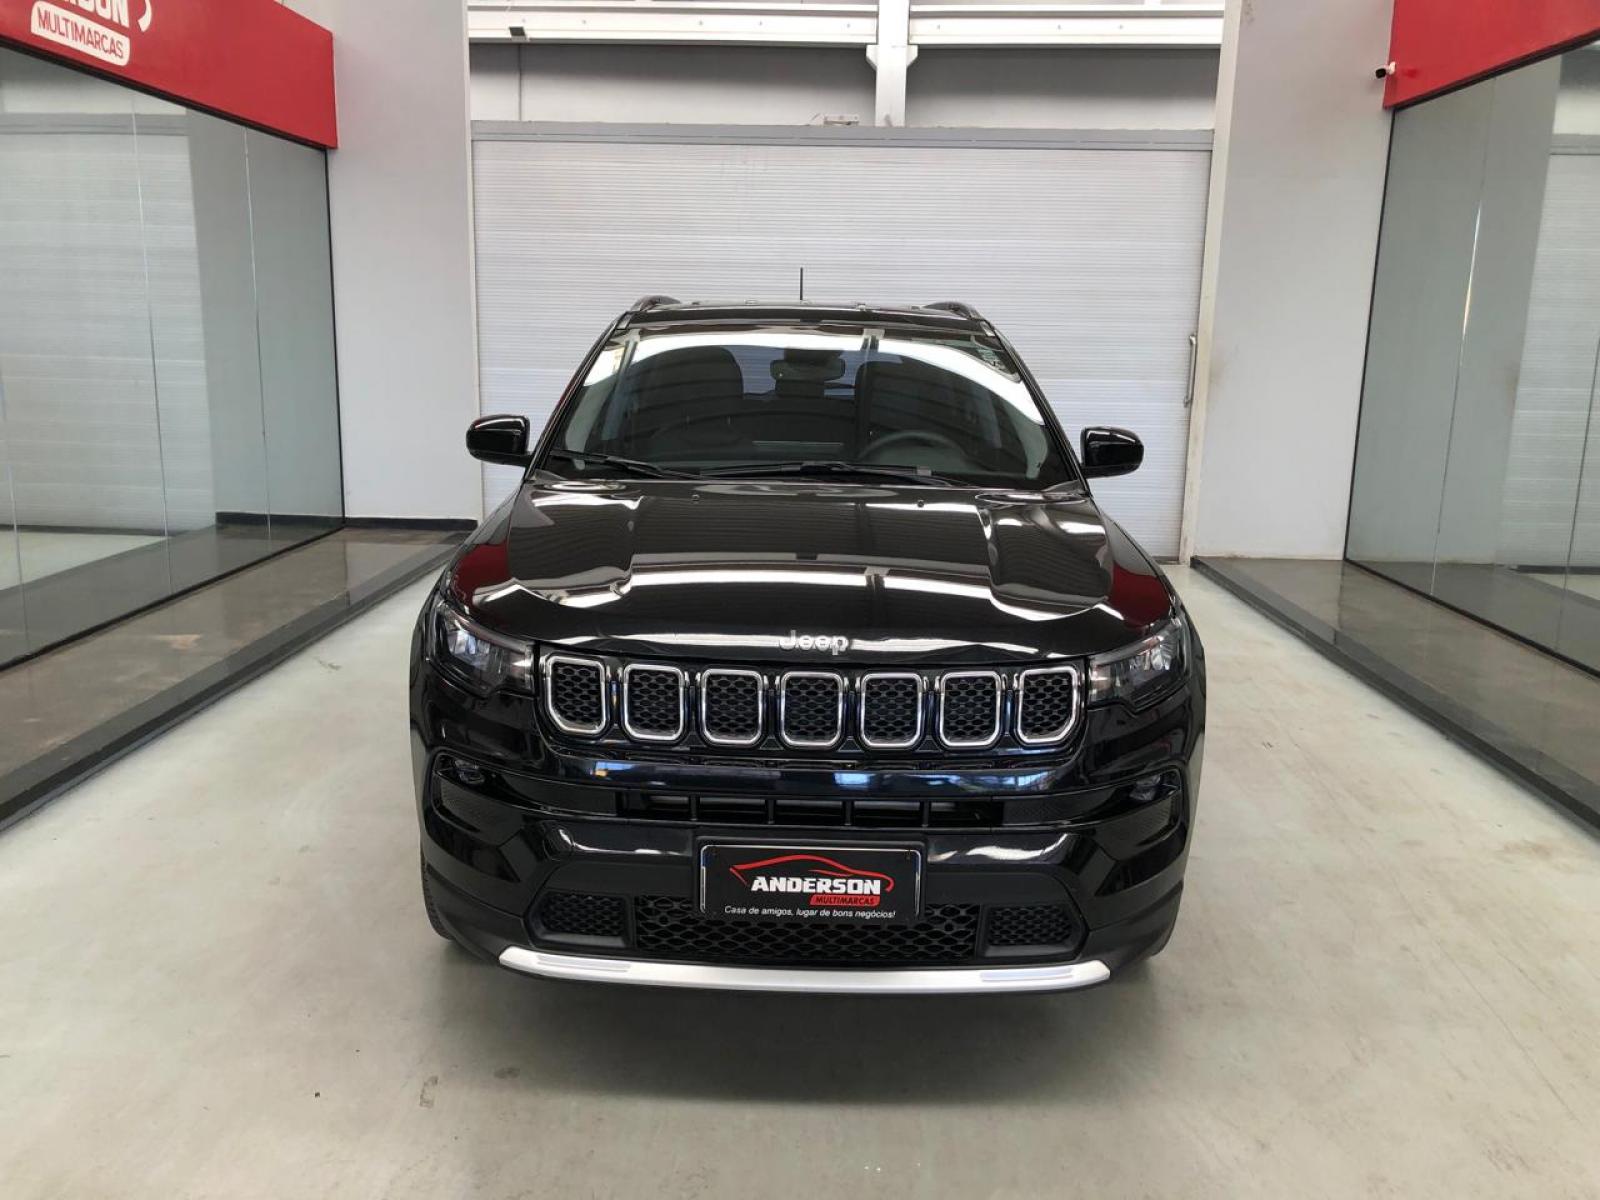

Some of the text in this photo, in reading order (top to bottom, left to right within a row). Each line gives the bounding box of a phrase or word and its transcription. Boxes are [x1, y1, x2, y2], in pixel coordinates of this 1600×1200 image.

[38, 8, 124, 59] MULTIMARCAS
[779, 629, 849, 655] Jeep
[751, 876, 880, 894] ANDERSON
[815, 896, 874, 905] MULTIMARCAS
[724, 905, 747, 914] Casa
[748, 906, 760, 914] de
[761, 907, 794, 917] amigos,
[795, 908, 818, 918] lugar
[832, 909, 853, 917] bons
[854, 910, 896, 919] negócios!
